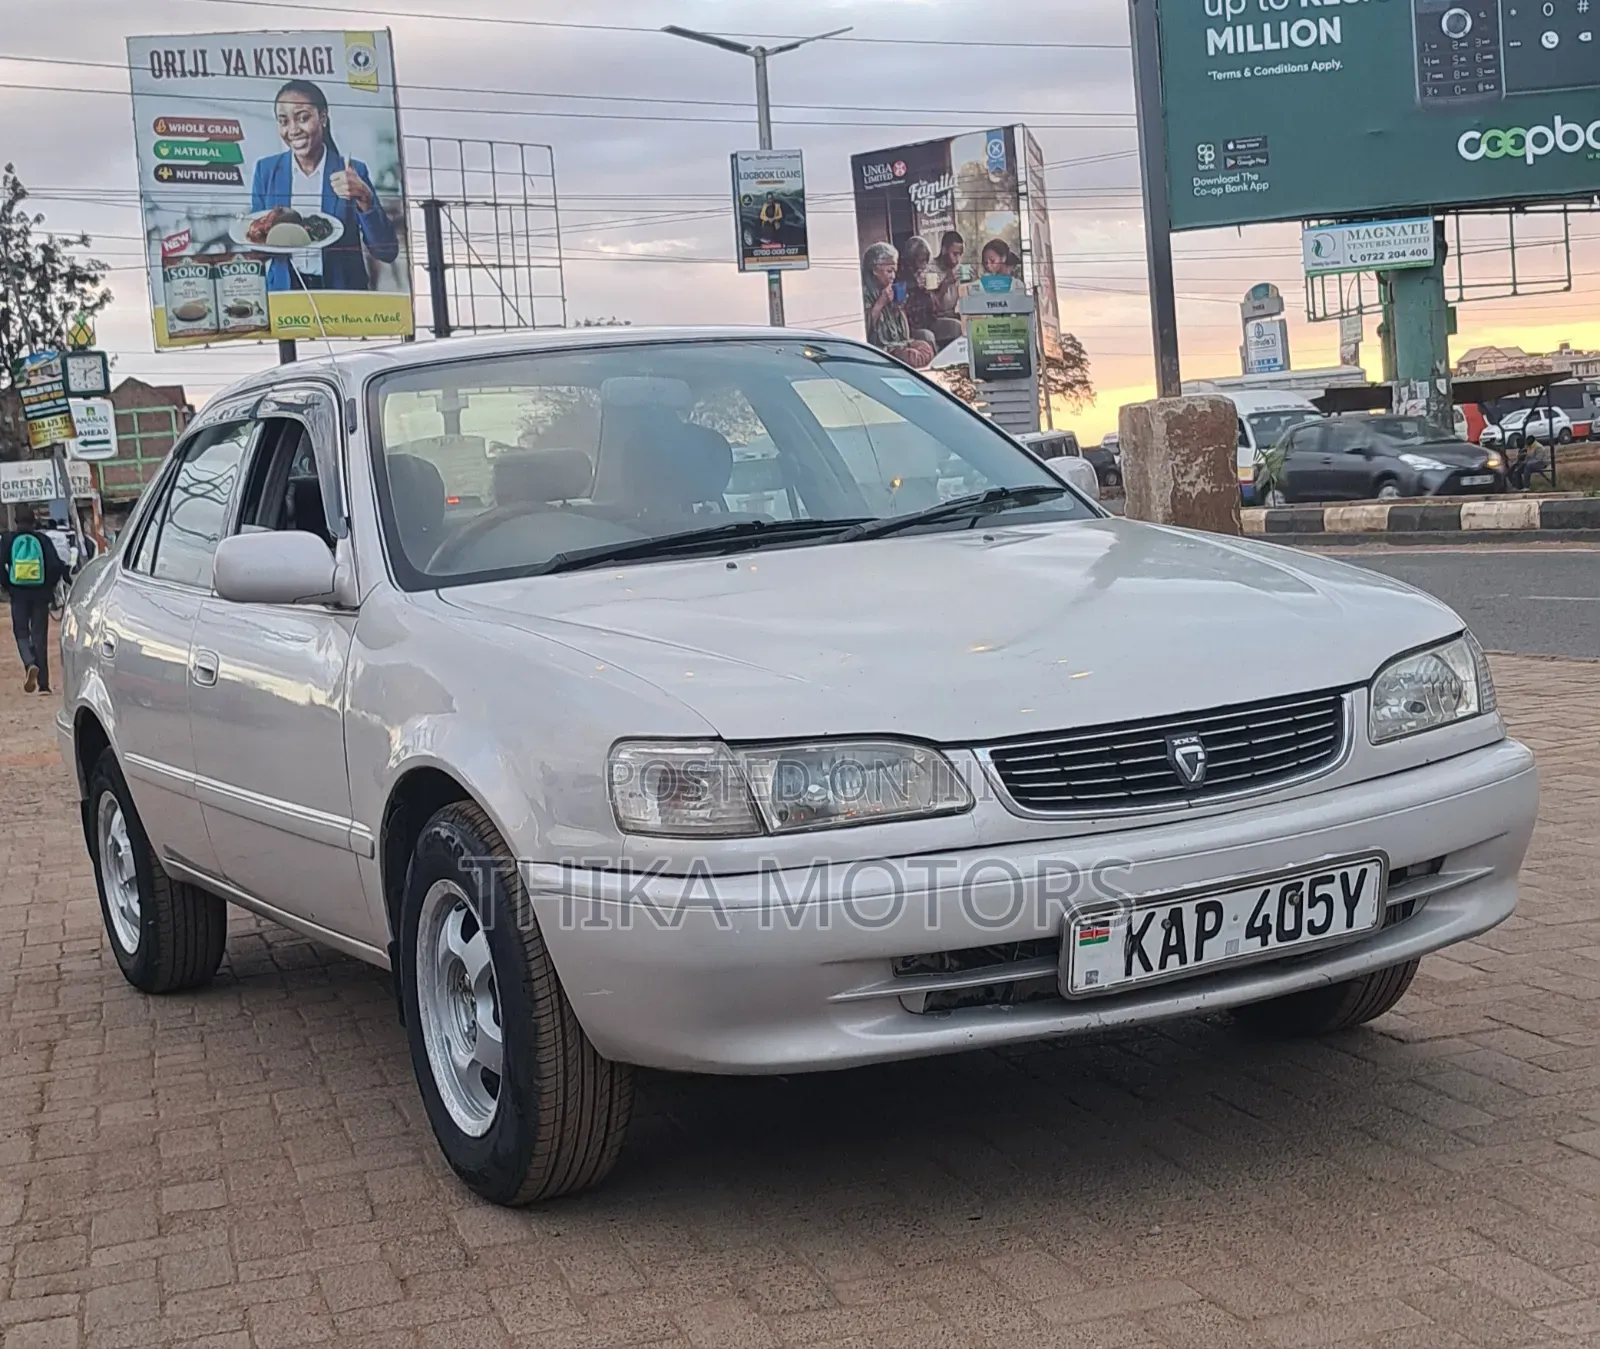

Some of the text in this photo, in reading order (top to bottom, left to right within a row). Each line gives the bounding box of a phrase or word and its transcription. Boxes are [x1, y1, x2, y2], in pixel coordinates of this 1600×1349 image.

[1206, 16, 1341, 56] MILLION
[221, 48, 248, 76] YA
[253, 46, 335, 76] KISIAGI
[1243, 68, 1251, 77] &
[1254, 63, 1309, 77] Conditions
[1311, 59, 1343, 72] Apply.
[168, 123, 240, 135] WHOLE GRAIN
[174, 147, 222, 158] NATURAL
[176, 169, 239, 181] NUTRITIOUS
[740, 170, 801, 180] LOGBOOK LOANS
[862, 163, 893, 177] UNGA
[864, 173, 893, 185] LIMITED
[1193, 172, 1259, 187] Download The
[1193, 181, 1269, 198] Co-op Bank App
[1347, 223, 1429, 241] MAGNATE
[163, 232, 189, 252] NEW
[1346, 236, 1430, 251] VENTURES LIMITED
[1360, 248, 1428, 262] 0722 204 400
[170, 266, 207, 279] SOKO
[222, 263, 258, 276] SOKO
[986, 301, 1008, 309] THIKA
[278, 315, 310, 326] SOKO
[342, 313, 363, 324] than
[373, 312, 401, 323] Meal
[78, 428, 109, 437] AHEAD
[2, 477, 52, 491] GRETSA
[2, 487, 54, 499] UNIVERSITY
[1123, 867, 1368, 977] KAP 405Y
